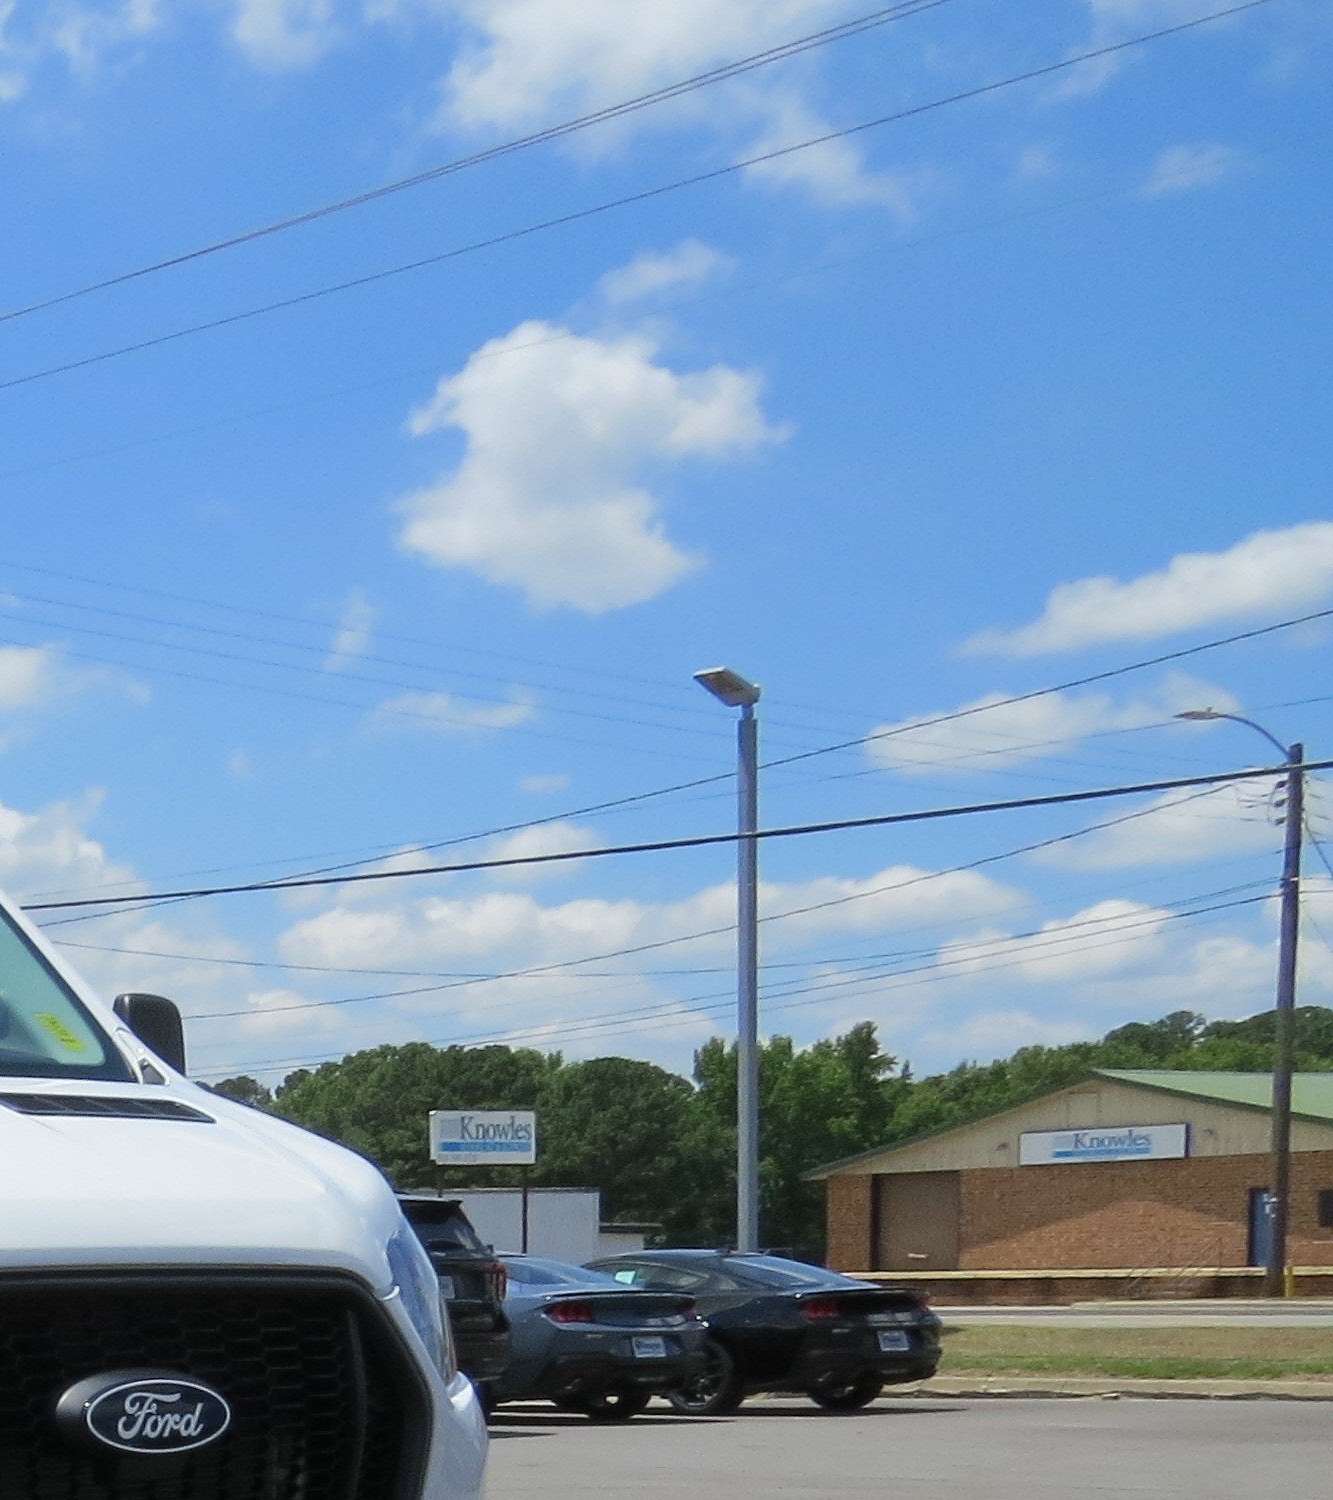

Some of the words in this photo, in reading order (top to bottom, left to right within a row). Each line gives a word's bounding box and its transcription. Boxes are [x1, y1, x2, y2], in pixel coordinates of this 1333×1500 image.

[460, 1115, 532, 1140] Knowles
[1073, 1129, 1152, 1149] Knowles
[117, 1392, 204, 1440] Ford
